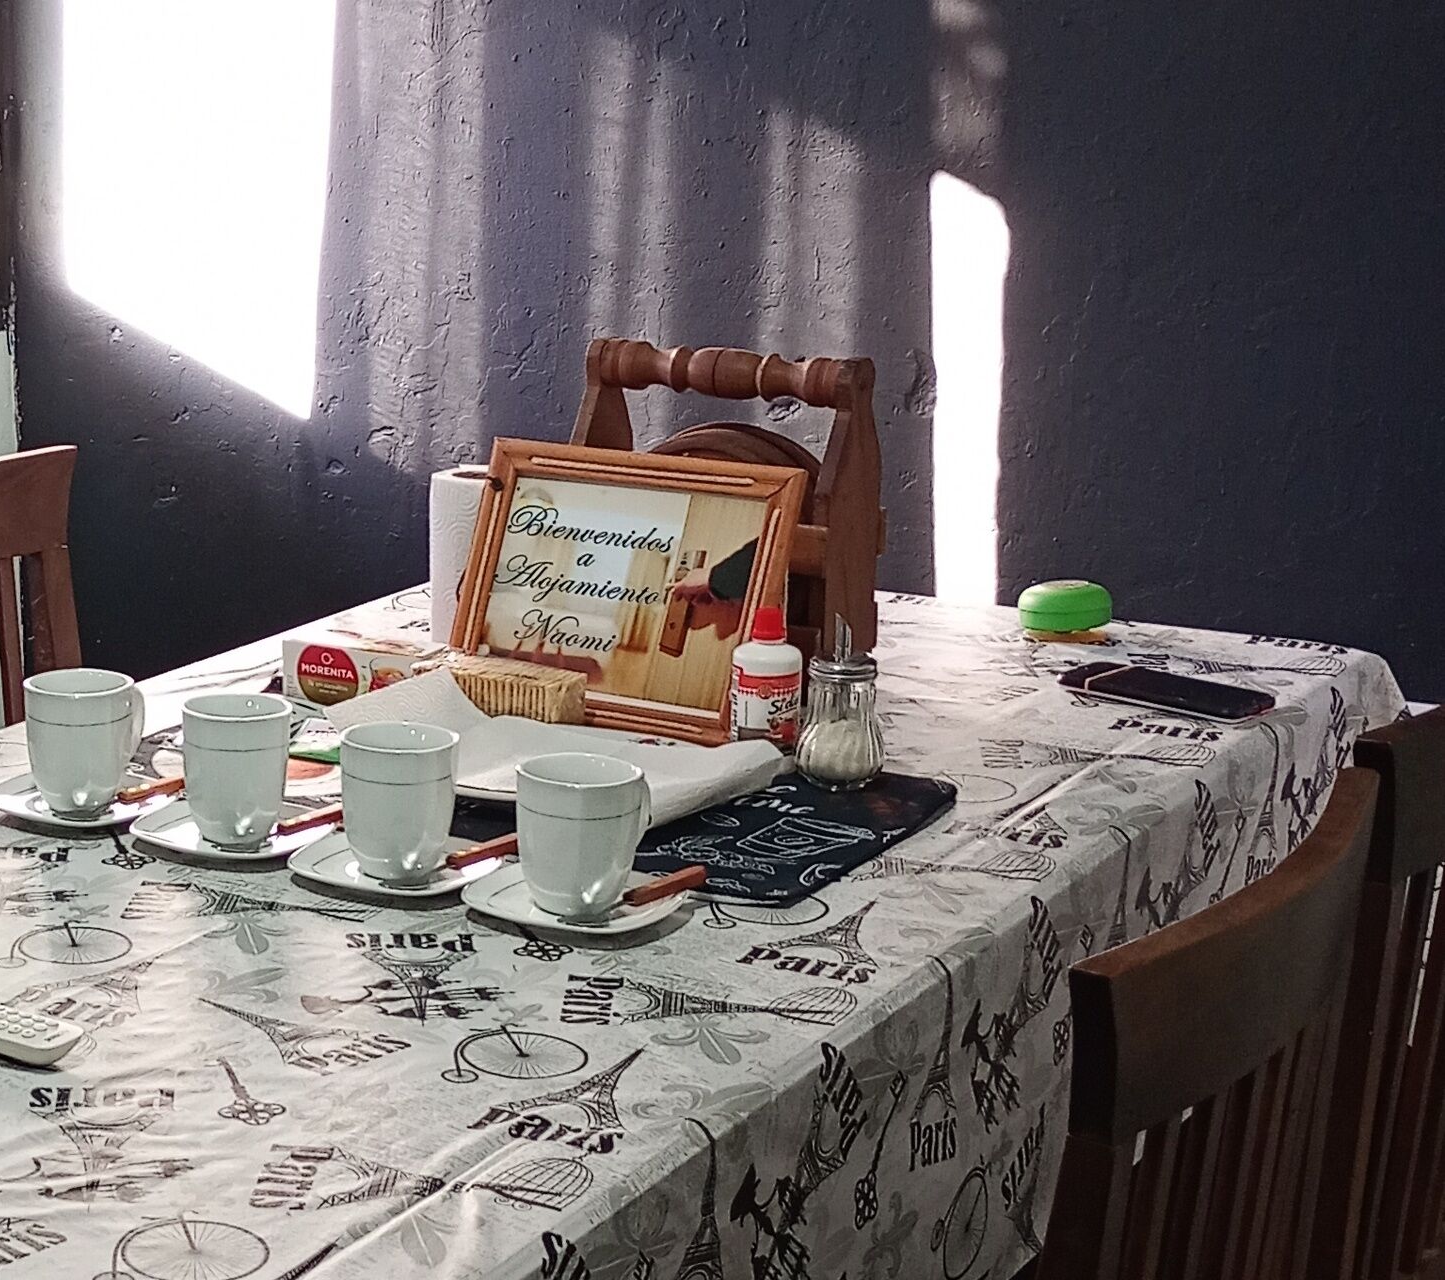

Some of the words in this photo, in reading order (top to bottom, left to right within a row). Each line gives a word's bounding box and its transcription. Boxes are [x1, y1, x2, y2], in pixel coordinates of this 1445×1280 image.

[507, 505, 675, 553] Bienvenidos
[494, 554, 662, 604] Alojamiento
[576, 552, 596, 567] a
[514, 608, 617, 652] Naomi
[301, 663, 354, 680] MORENITA
